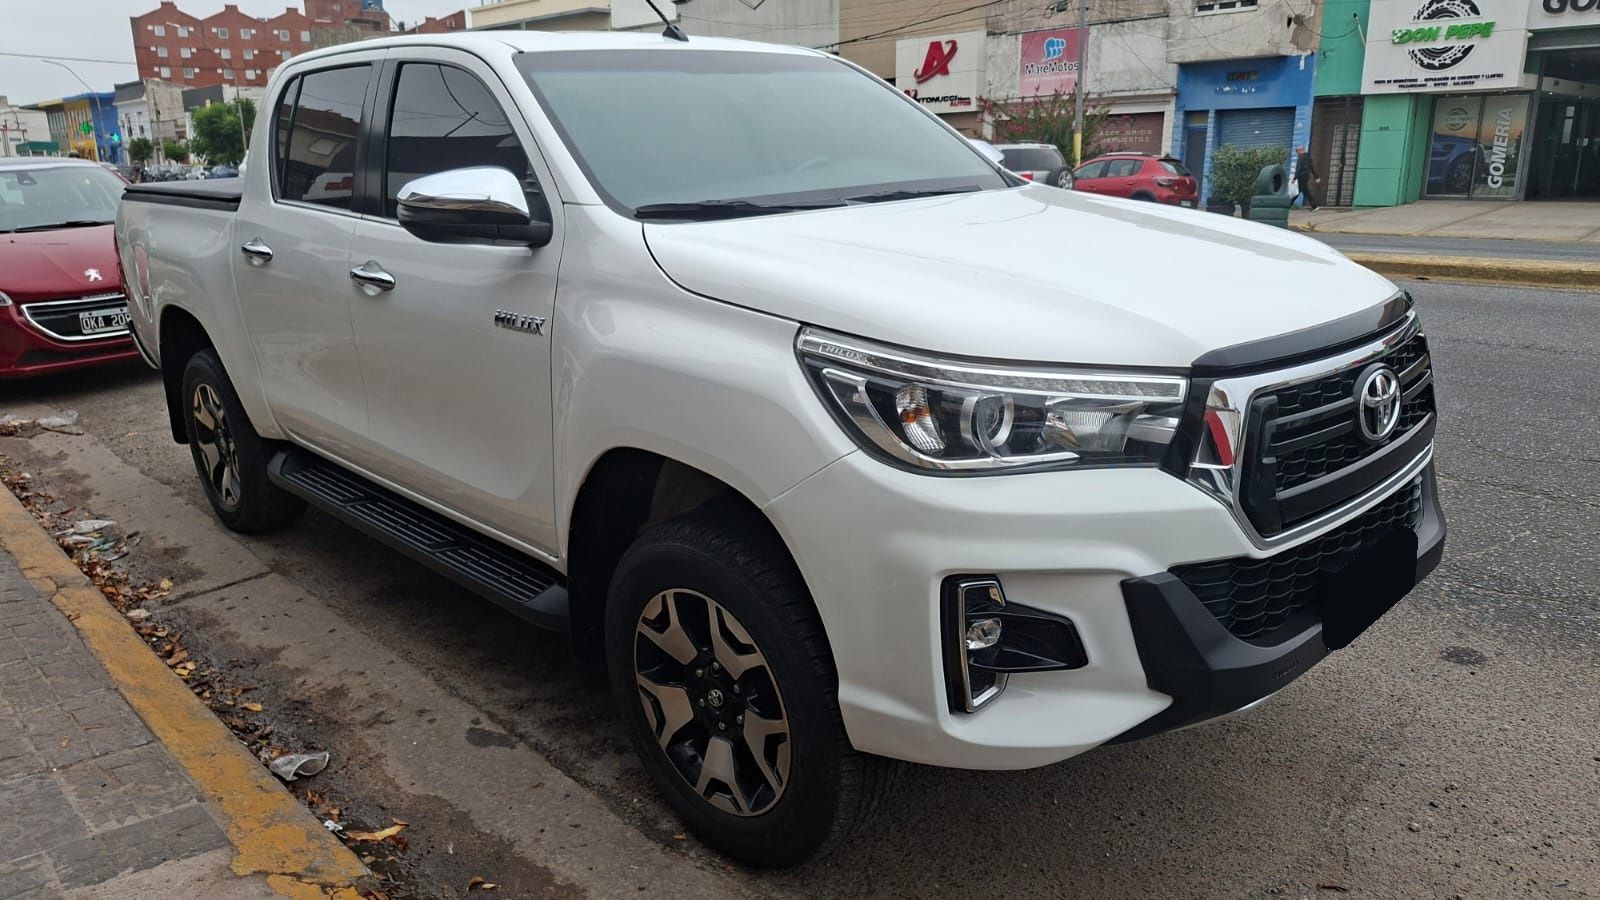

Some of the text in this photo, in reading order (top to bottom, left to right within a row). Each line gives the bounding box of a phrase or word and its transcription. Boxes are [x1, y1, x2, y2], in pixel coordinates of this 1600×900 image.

[1392, 21, 1496, 44] DON PEPE
[1025, 61, 1080, 74] MareMotos
[82, 316, 105, 329] OKA
[494, 309, 546, 336] HILUX
[824, 344, 862, 361] HILUX
